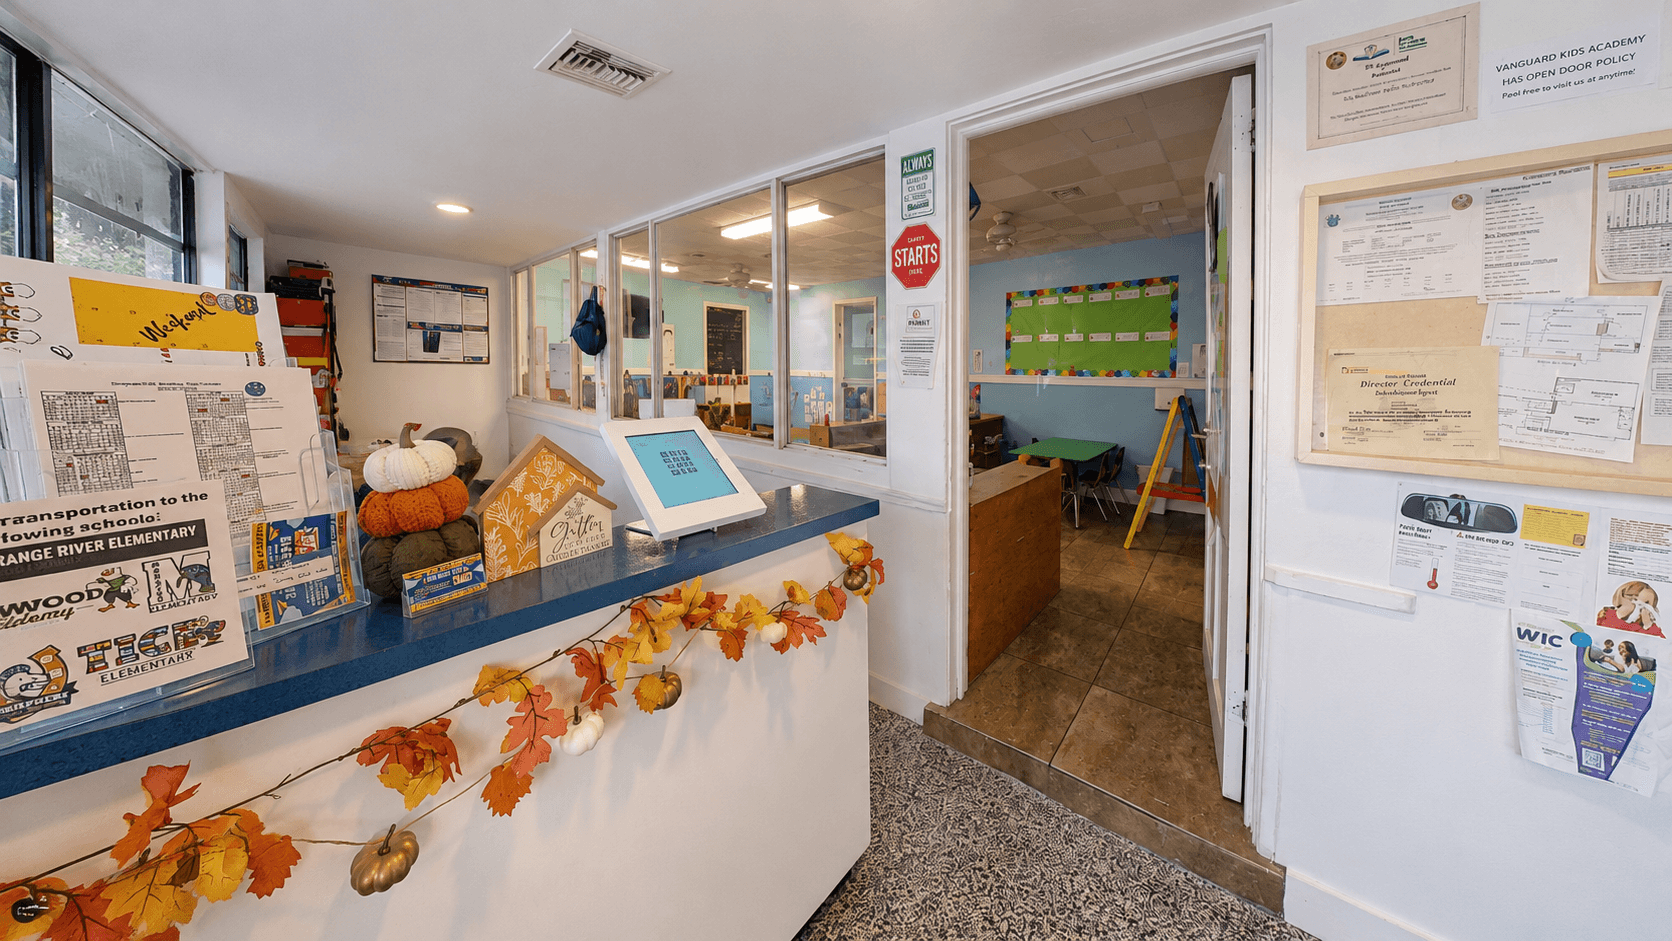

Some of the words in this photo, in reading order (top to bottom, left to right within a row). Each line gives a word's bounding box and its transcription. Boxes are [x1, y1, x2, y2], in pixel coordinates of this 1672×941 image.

[1495, 53, 1557, 73] VANGUARD
[1559, 47, 1585, 60] KIDS
[1588, 34, 1646, 53] ACADEMY
[1502, 75, 1524, 86] HAS
[1526, 68, 1556, 81] OPEN
[1559, 61, 1593, 75] DOOR
[1596, 52, 1636, 67] POLICY
[1573, 78, 1585, 86] us
[894, 242, 938, 268] STARTS
[160, 496, 178, 506] to
[181, 492, 208, 503] the
[57, 539, 105, 557] RIVER
[108, 524, 197, 549] ELEMENTARY
[1516, 626, 1564, 648] WIC
